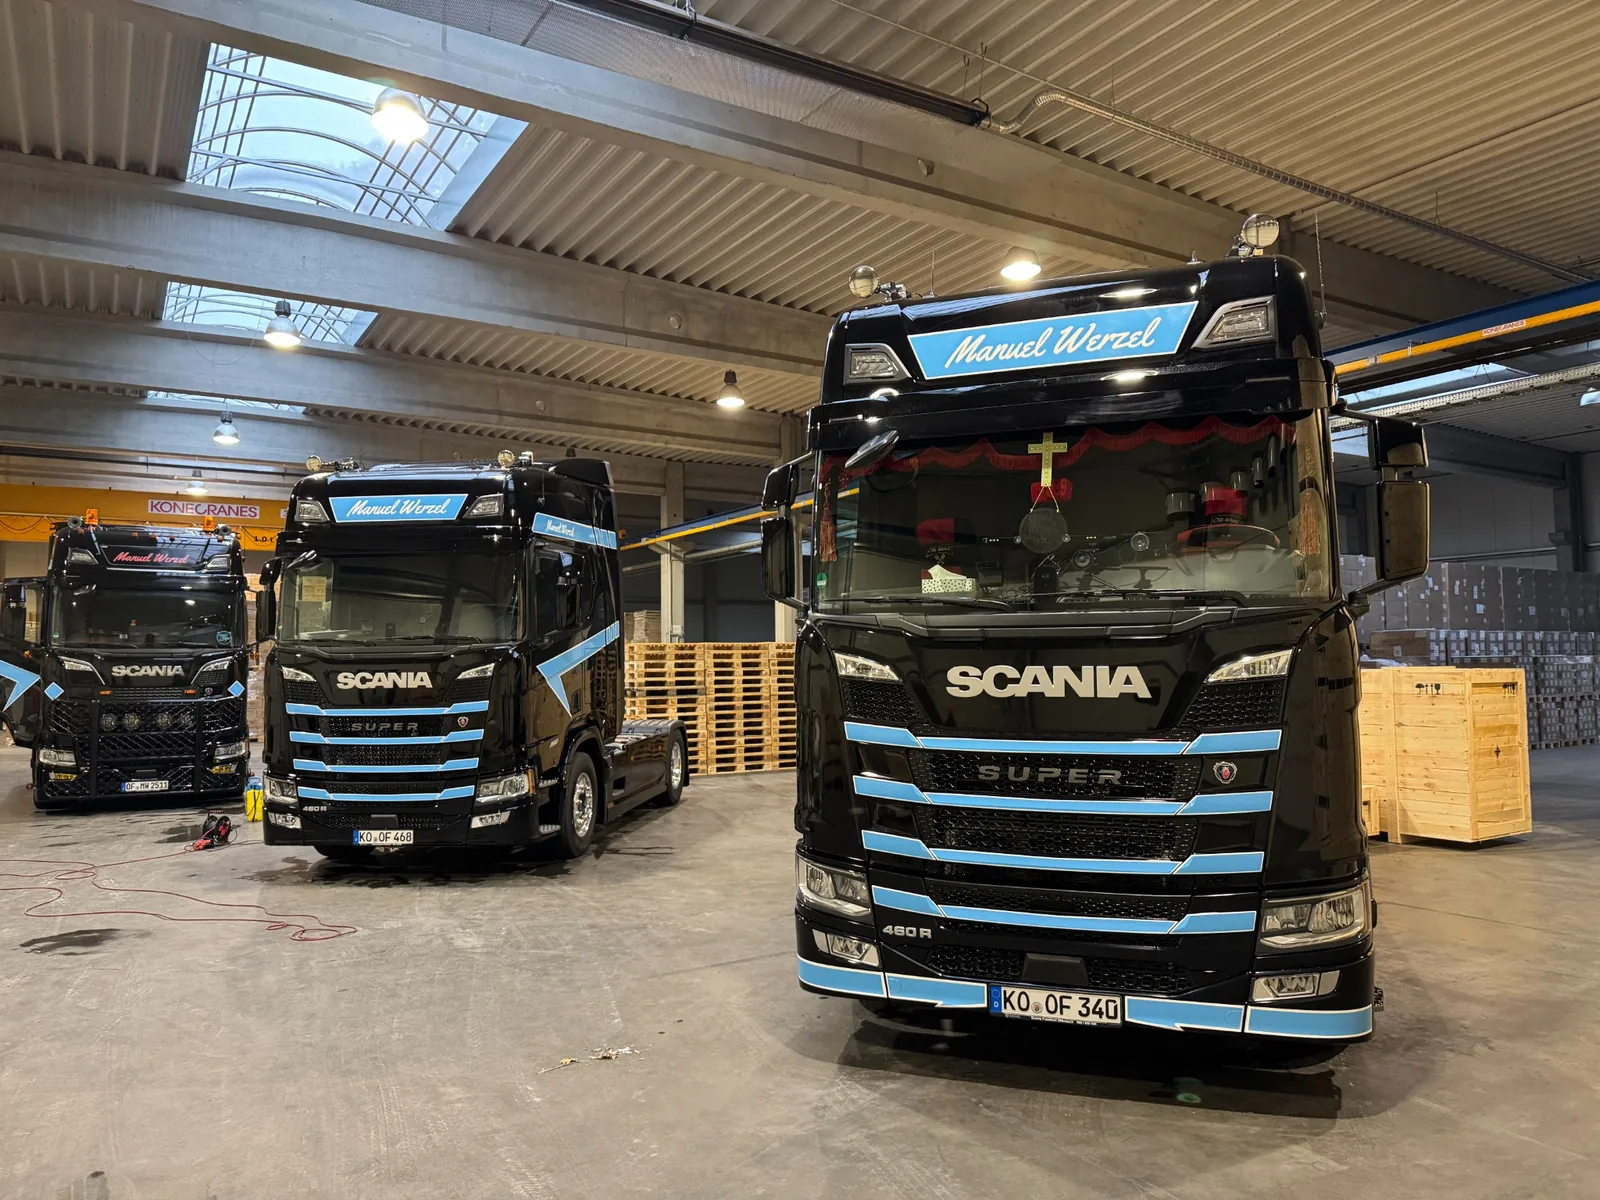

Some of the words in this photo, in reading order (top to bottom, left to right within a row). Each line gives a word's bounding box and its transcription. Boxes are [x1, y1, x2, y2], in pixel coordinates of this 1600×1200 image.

[1483, 320, 1525, 335] KONECRANES
[944, 327, 1053, 368] Manuel
[1053, 317, 1162, 355] Werzel
[150, 500, 258, 518] KONECRANES
[346, 499, 400, 517] Manuel
[399, 498, 451, 515] Werzel
[113, 551, 153, 563] Manuel
[111, 665, 186, 677] SCANIA
[336, 671, 433, 690] SCANIA
[946, 665, 1152, 699] SCANIA
[351, 722, 419, 732] SUPER
[978, 765, 1123, 785] SUPER
[150, 781, 168, 789] 2511
[359, 832, 372, 842] KO
[378, 832, 391, 842] OF
[393, 831, 412, 842] 468
[882, 925, 917, 938] 460
[919, 927, 932, 939] R
[1003, 989, 1030, 1012] KO
[1045, 993, 1072, 1015] OF
[1078, 996, 1118, 1020] 340
